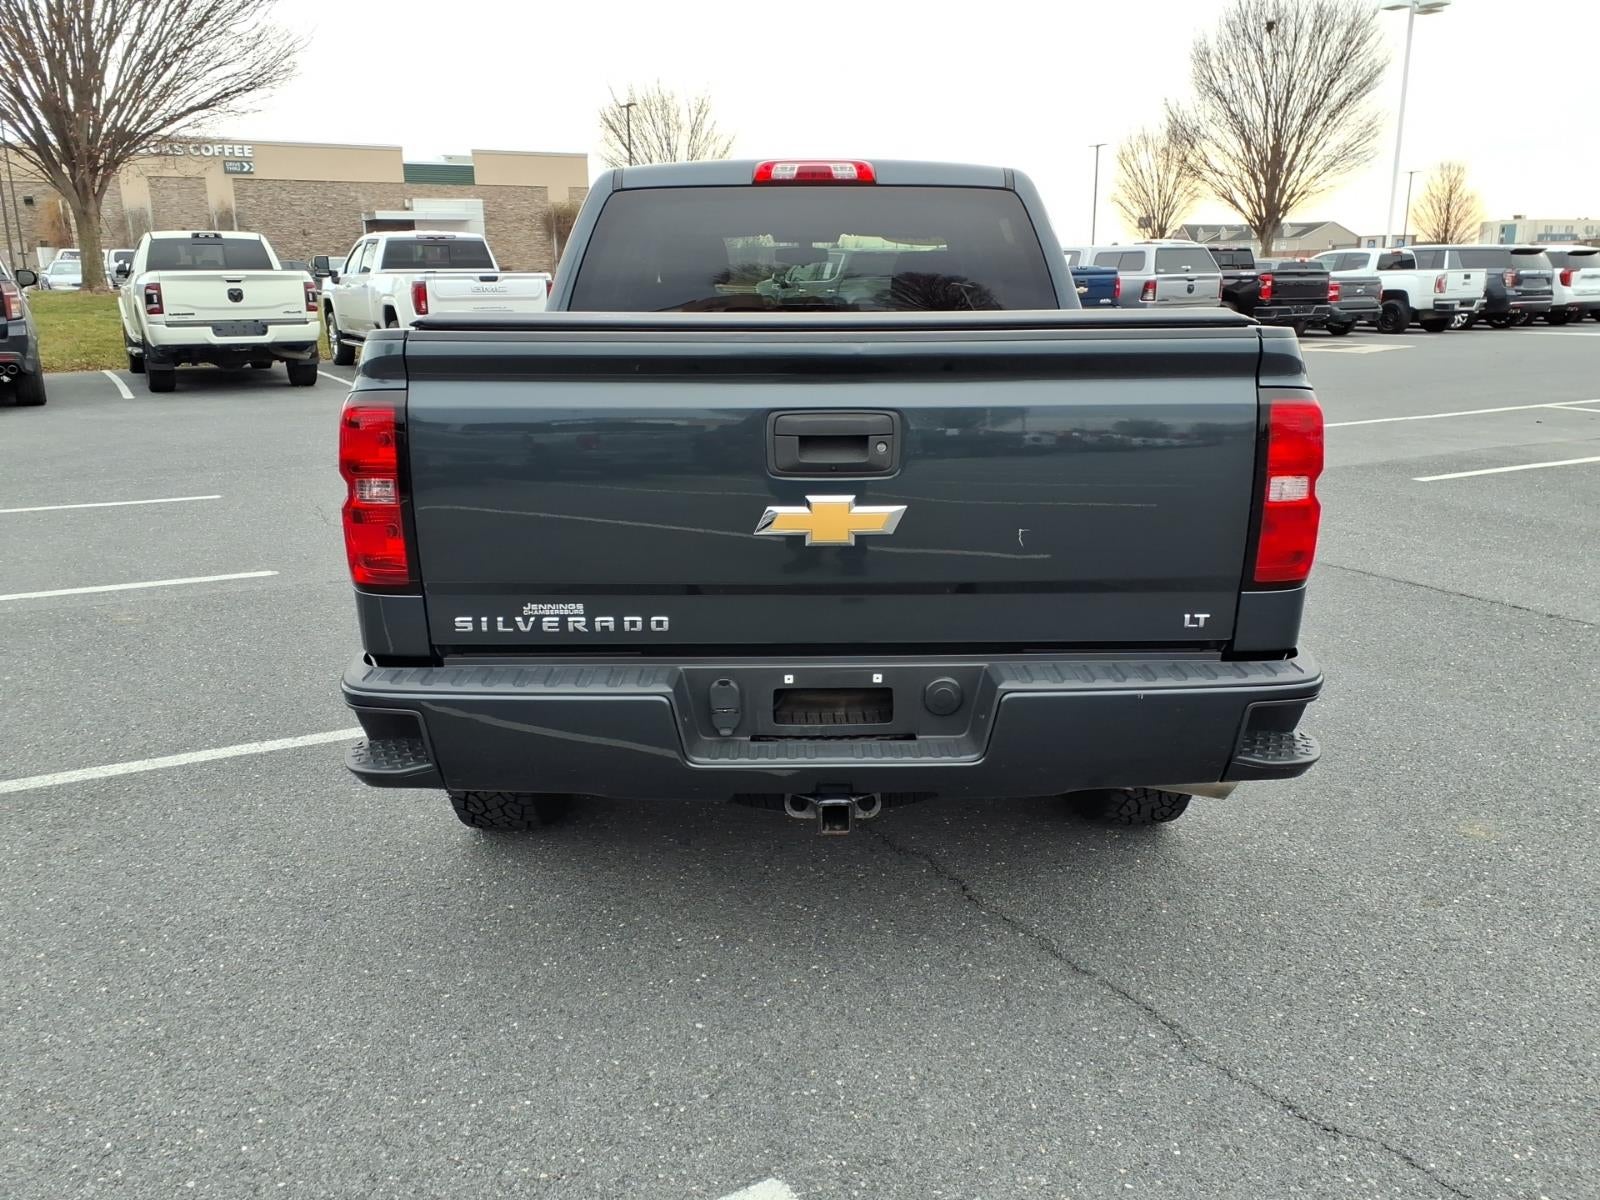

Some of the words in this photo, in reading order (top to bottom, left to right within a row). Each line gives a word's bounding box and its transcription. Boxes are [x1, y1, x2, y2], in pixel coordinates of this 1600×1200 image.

[189, 143, 253, 157] COFFEE
[522, 602, 585, 610] JENNINGS
[454, 616, 670, 633] SILVERADO
[1184, 613, 1211, 628] LT
